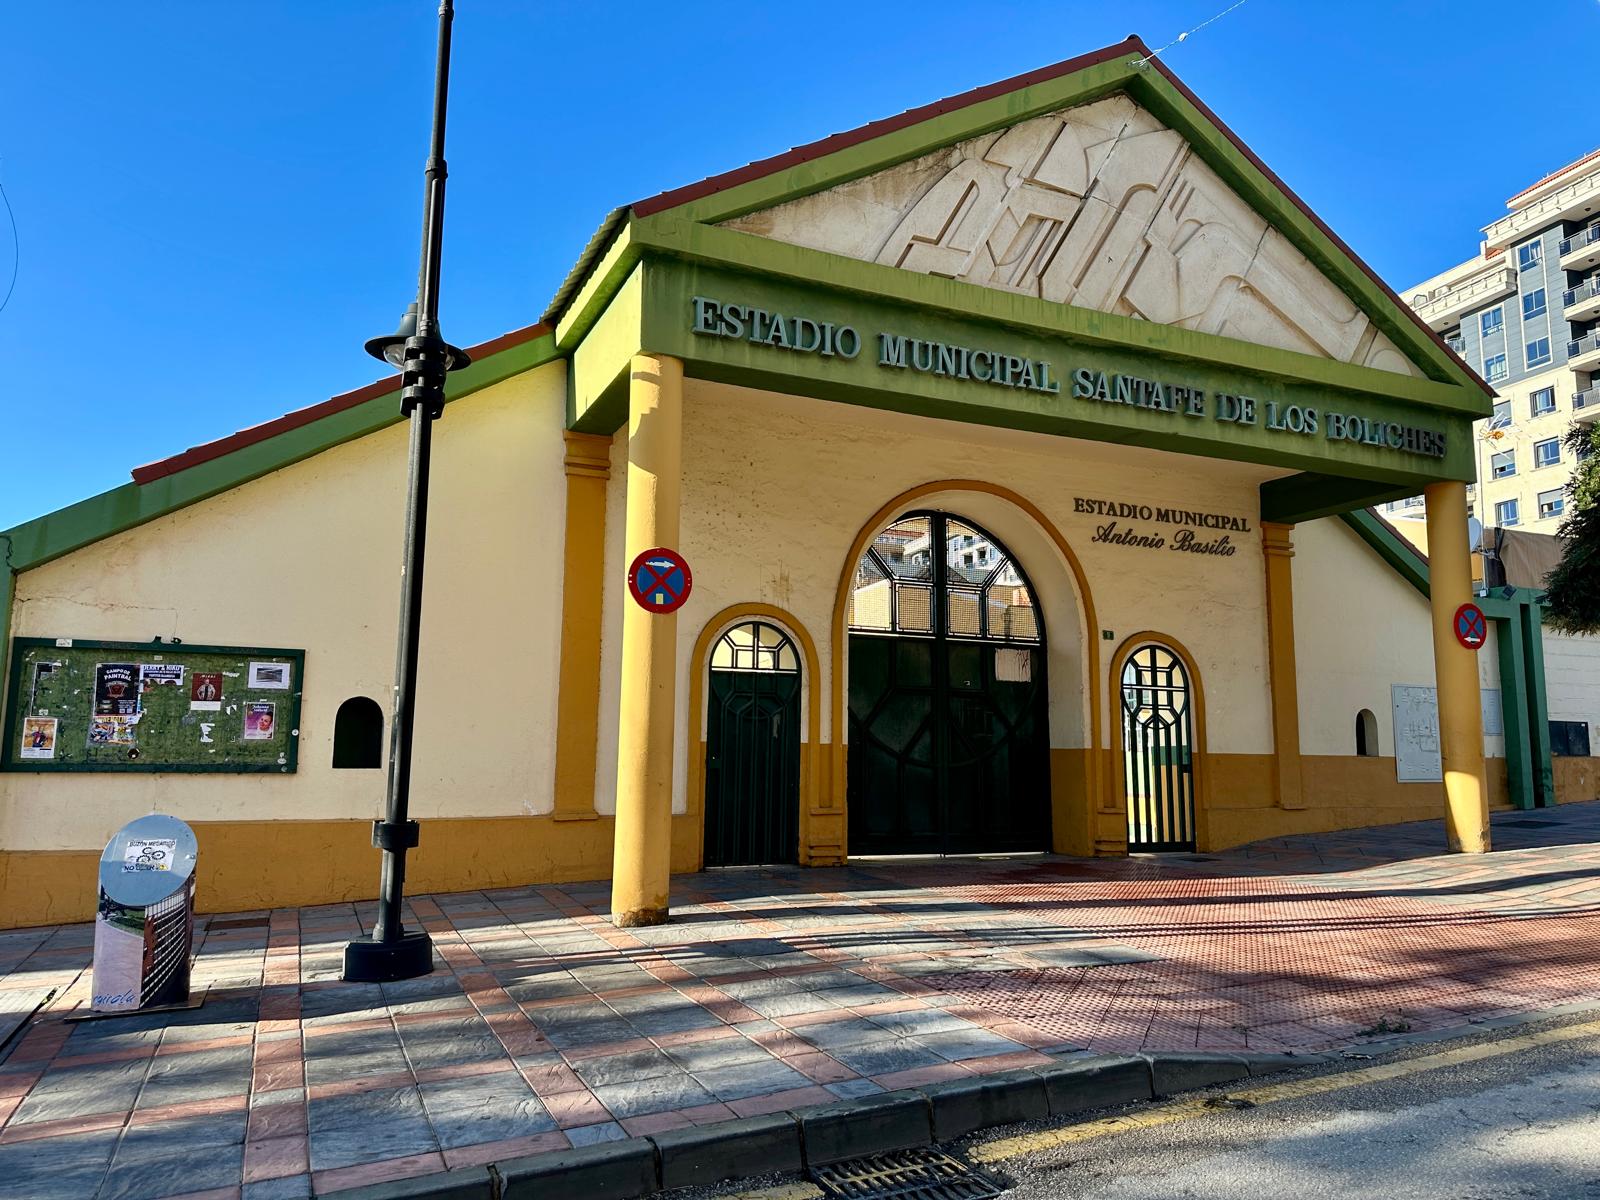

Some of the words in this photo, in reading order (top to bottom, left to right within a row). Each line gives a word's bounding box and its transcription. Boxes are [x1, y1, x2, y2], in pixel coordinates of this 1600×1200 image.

[692, 296, 862, 360] ESTADIO
[877, 332, 1061, 394] MUNICIPAL
[1215, 391, 1258, 425] DE
[1265, 401, 1319, 435] LOS
[1325, 411, 1448, 459] BOLICHES
[1073, 497, 1153, 521] ESTADIO
[1156, 507, 1251, 533] MUNICIPAL
[1092, 521, 1165, 549] Antonio
[1169, 528, 1236, 557] Basilio
